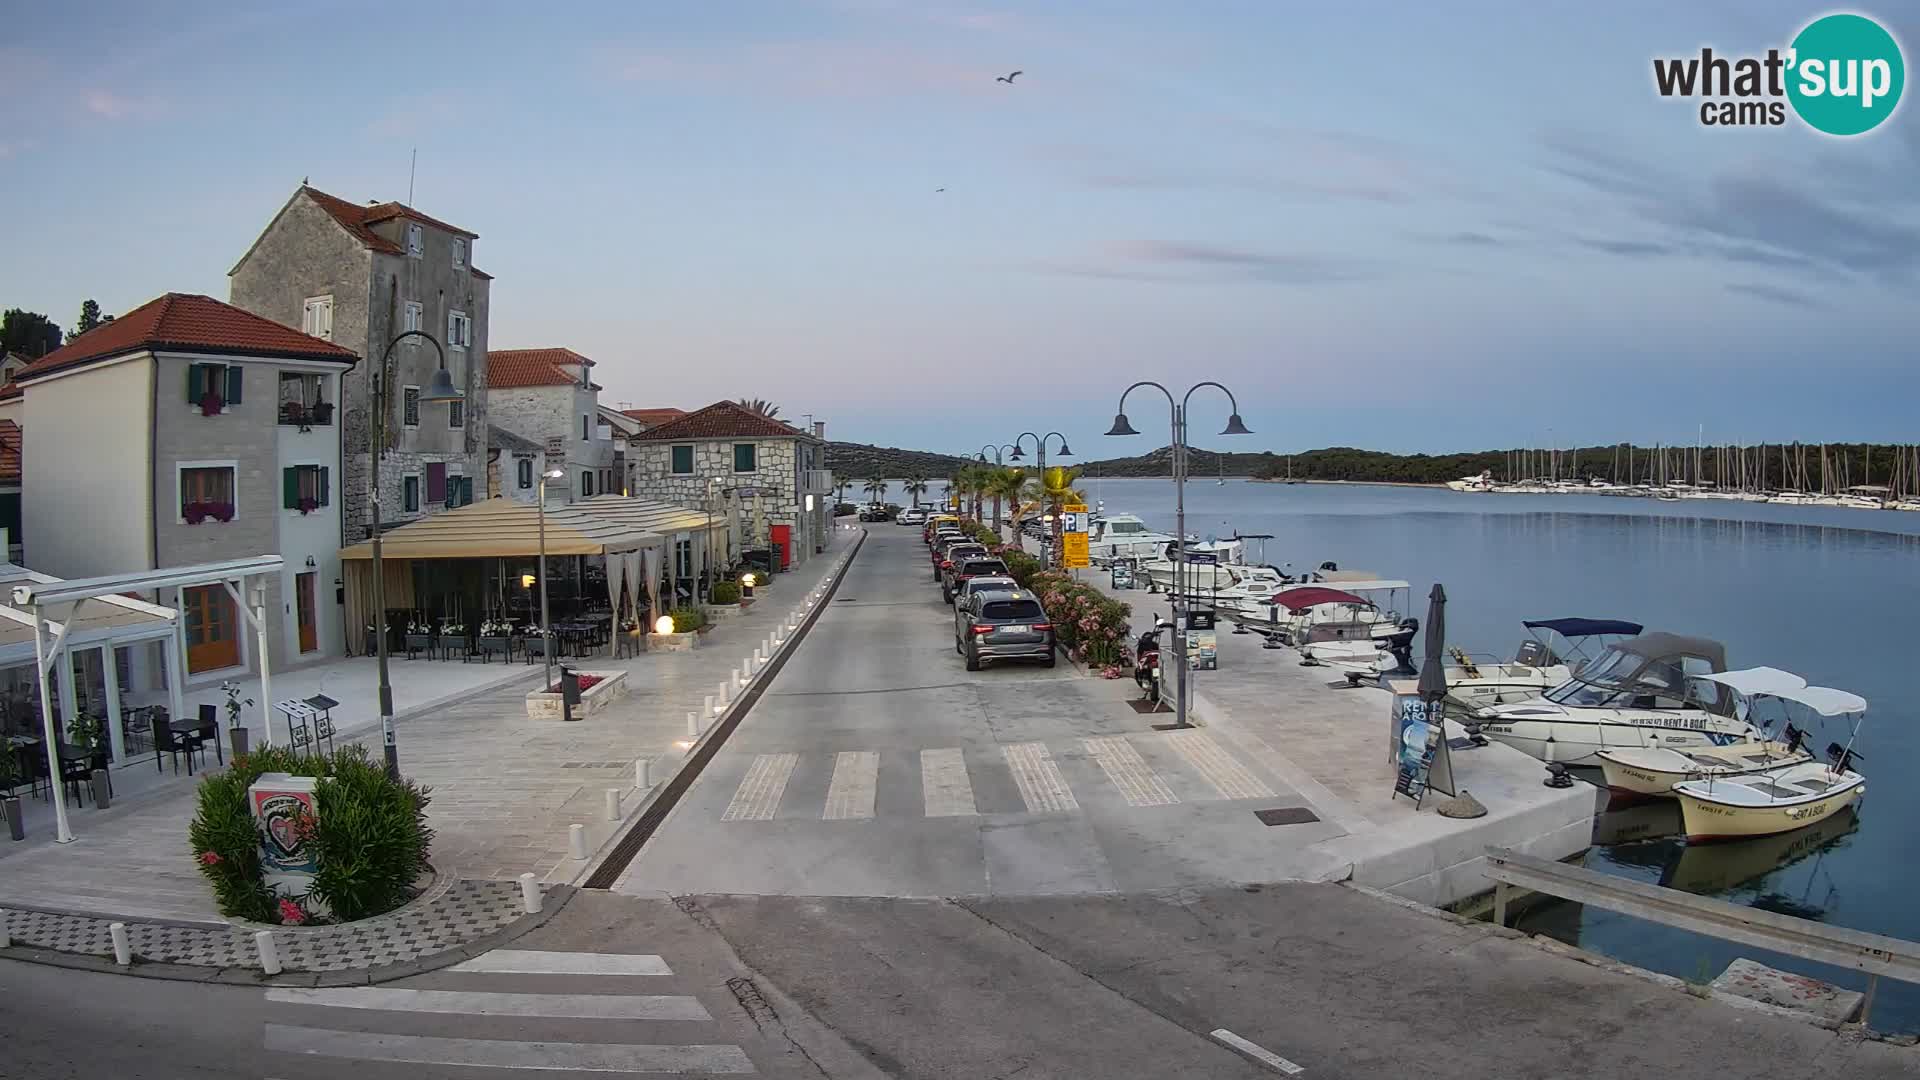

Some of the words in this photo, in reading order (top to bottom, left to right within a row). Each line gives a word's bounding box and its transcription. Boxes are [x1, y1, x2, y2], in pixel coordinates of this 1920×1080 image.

[1065, 514, 1076, 531] P
[1663, 718, 1683, 728] RENT
[1689, 719, 1708, 730] BOAT
